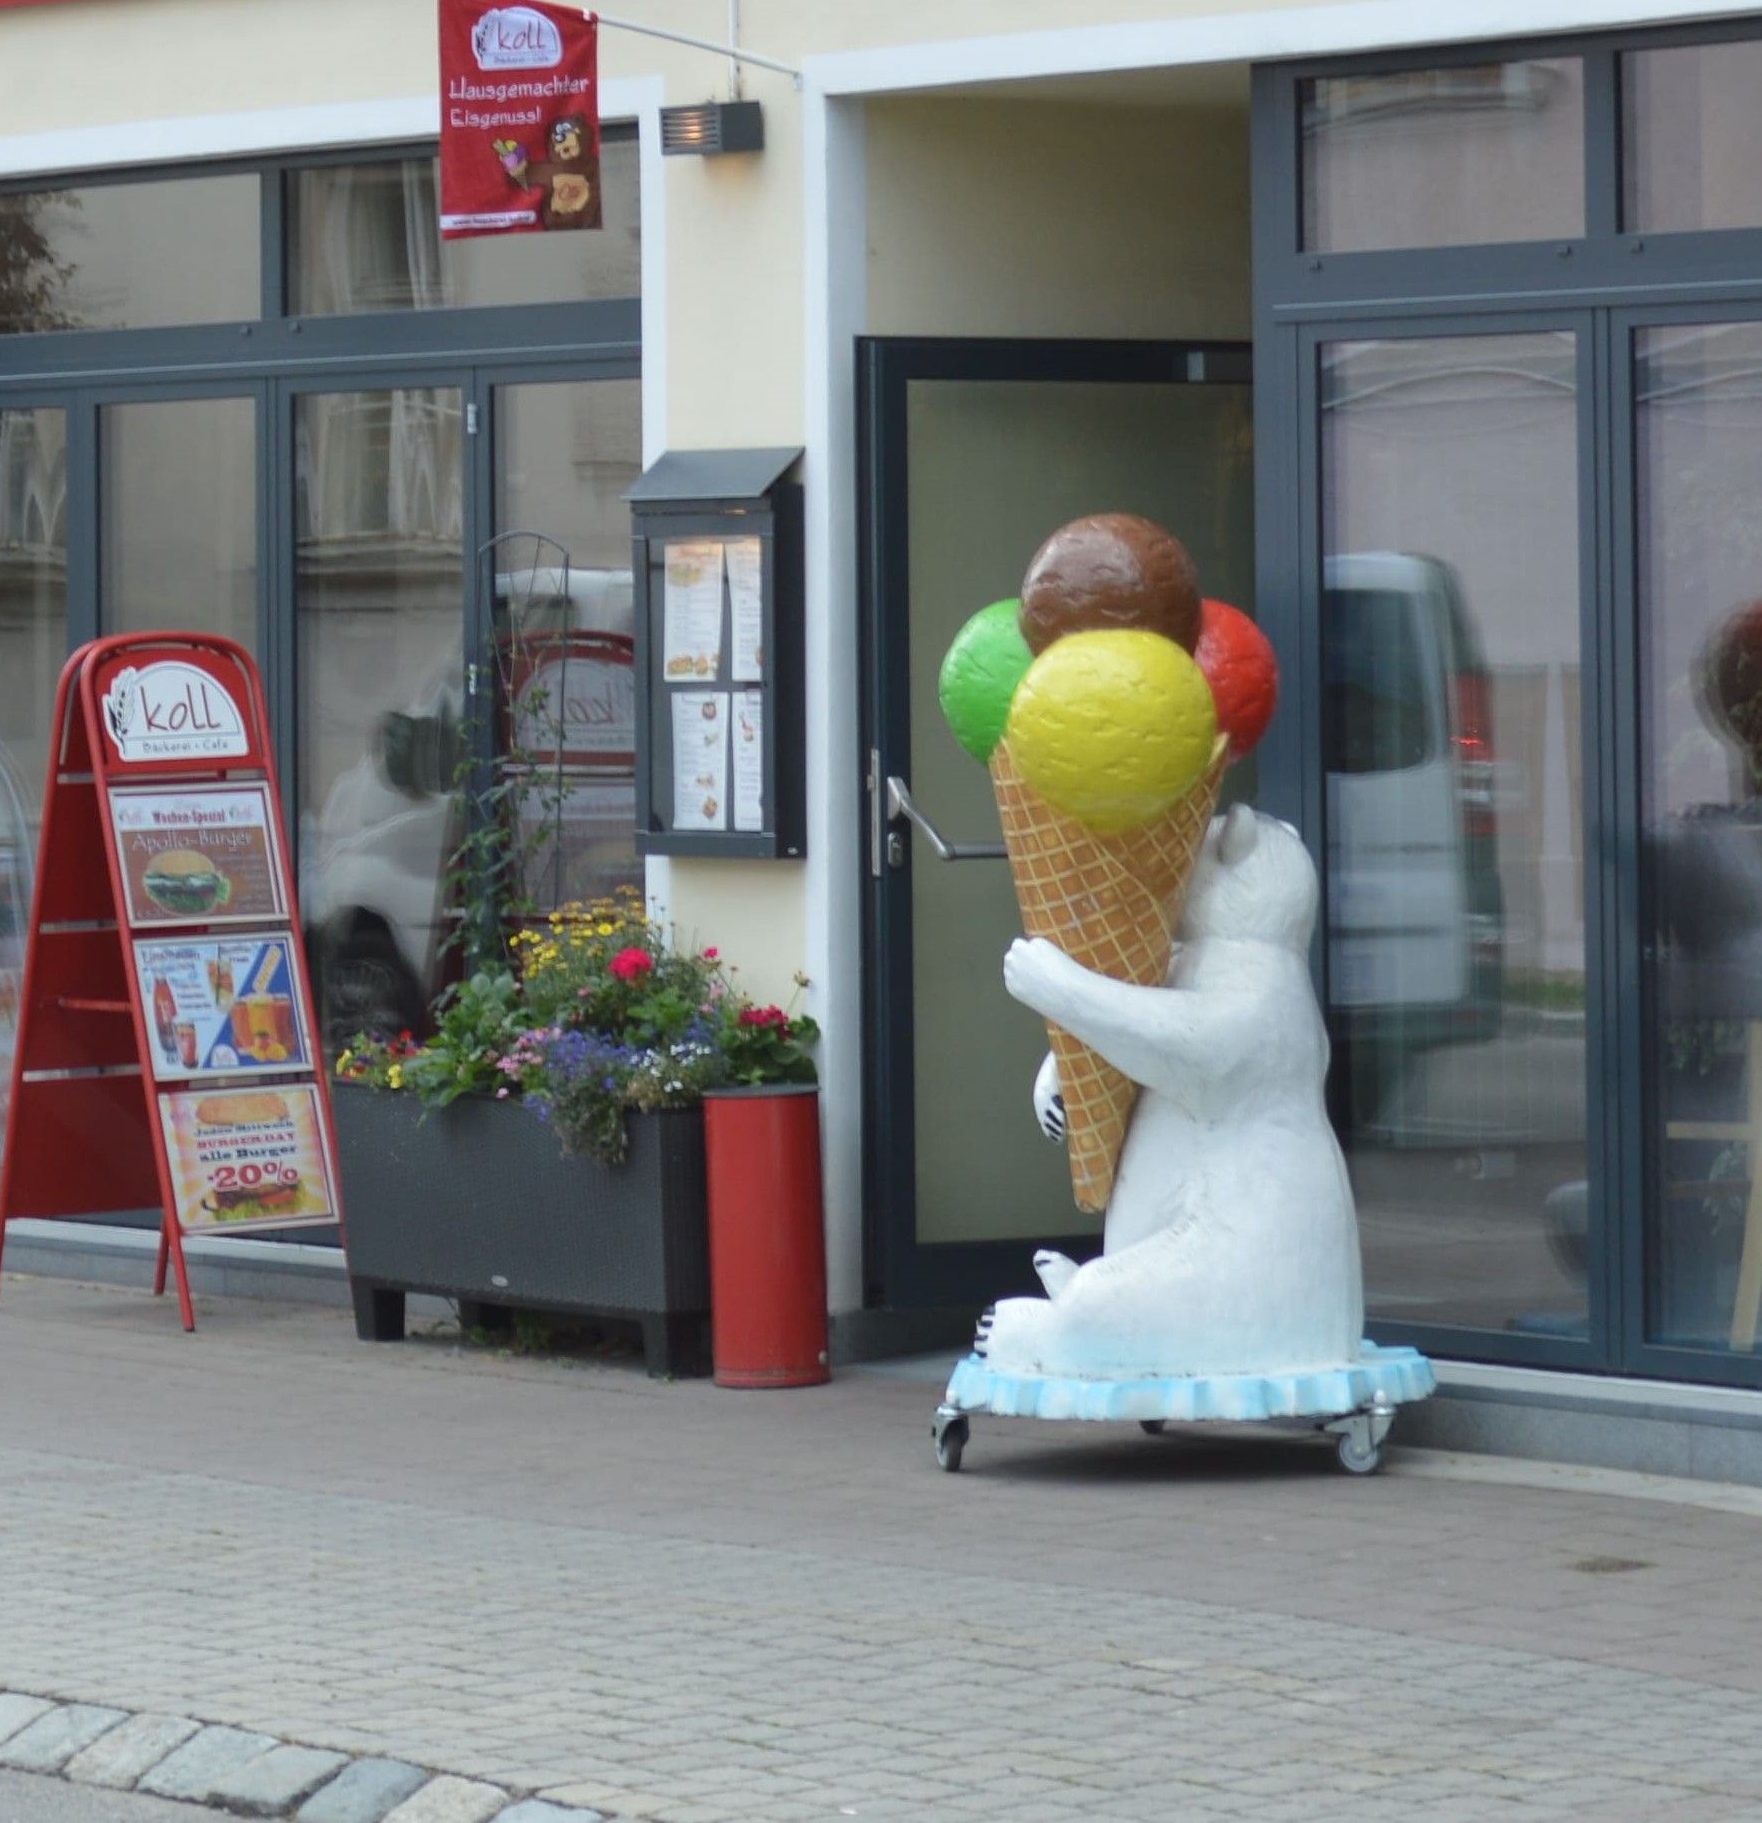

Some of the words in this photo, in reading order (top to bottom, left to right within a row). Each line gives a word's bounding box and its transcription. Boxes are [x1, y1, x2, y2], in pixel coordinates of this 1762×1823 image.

[498, 19, 546, 50] koll
[448, 75, 590, 102] Hausgemachter
[139, 681, 222, 732] koll
